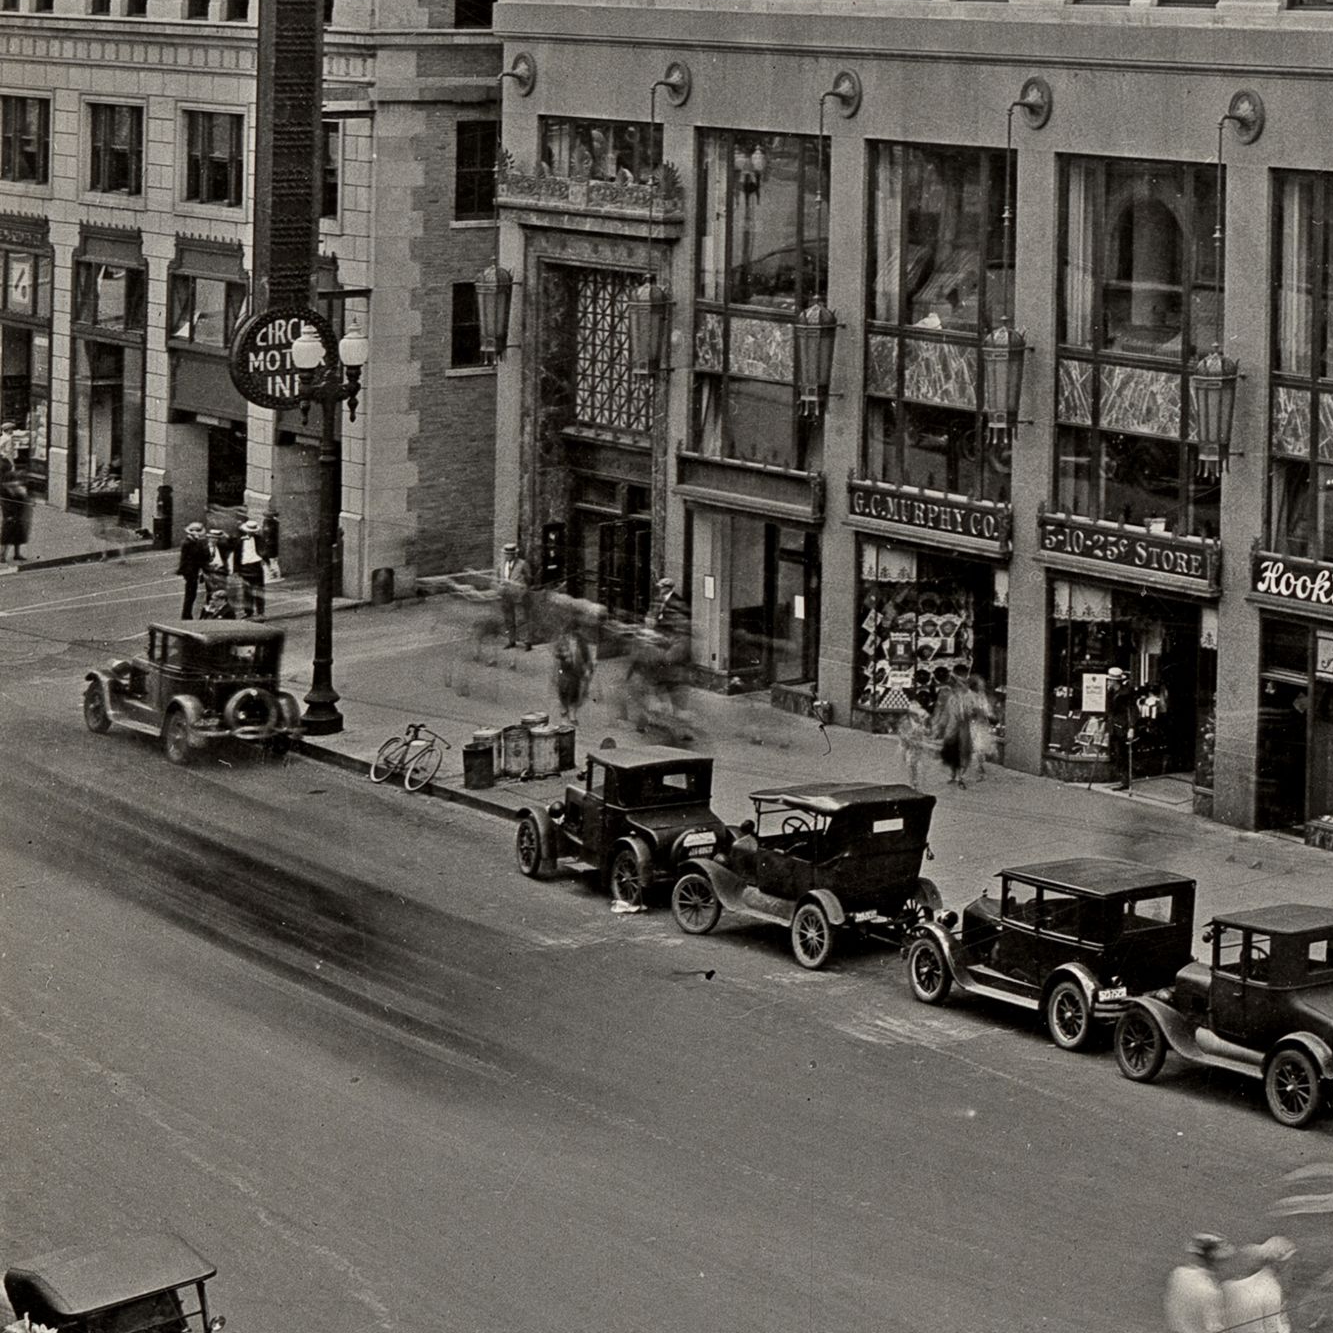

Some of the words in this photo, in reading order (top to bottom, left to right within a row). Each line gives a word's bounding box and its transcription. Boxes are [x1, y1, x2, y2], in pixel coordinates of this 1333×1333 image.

[256, 317, 305, 346] CIRC
[969, 513, 1000, 539] CO.
[1134, 540, 1203, 576] STORE
